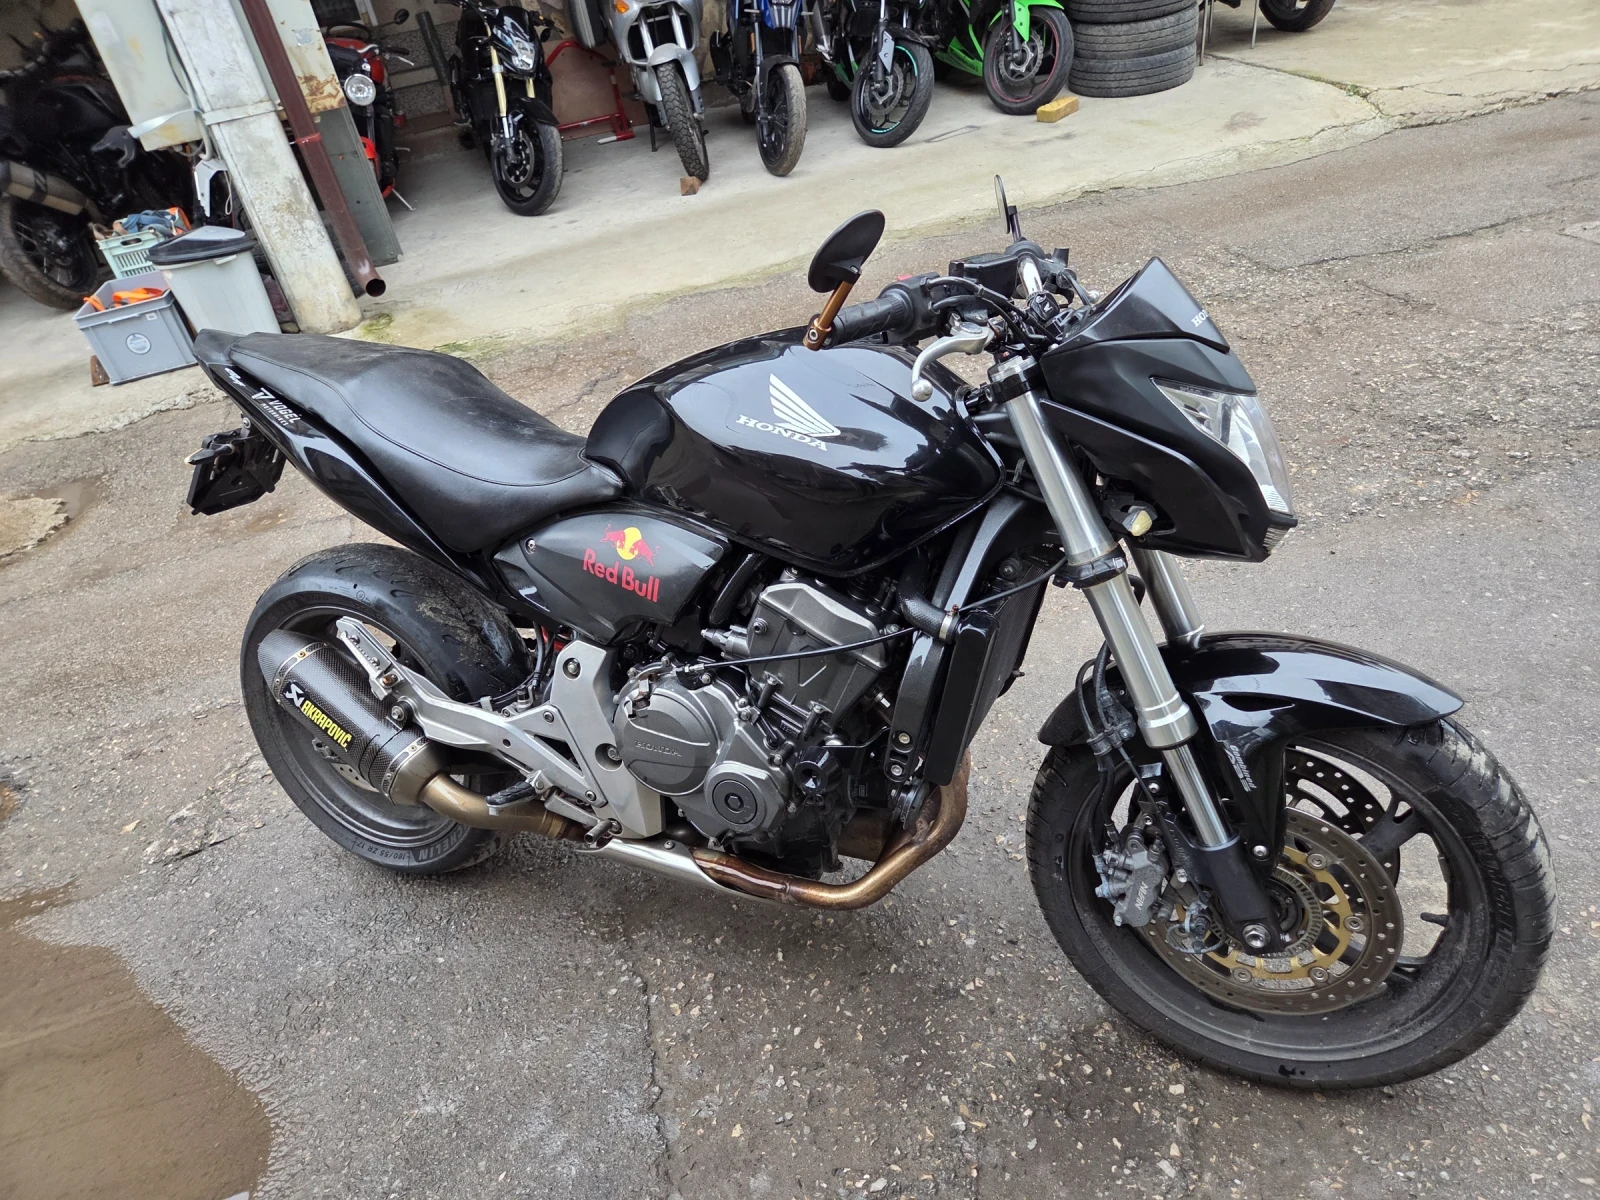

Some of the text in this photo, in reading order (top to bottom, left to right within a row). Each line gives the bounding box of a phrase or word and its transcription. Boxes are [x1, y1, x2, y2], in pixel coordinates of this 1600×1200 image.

[260, 403, 289, 426] MOTORBIKES
[269, 400, 301, 424] VOGEL
[735, 414, 828, 452] HONDA
[583, 547, 660, 603] Red Bull
[634, 740, 683, 757] HONDA
[1229, 744, 1257, 789] Combined
[356, 841, 365, 849] 17
[368, 846, 379, 854] ZR
